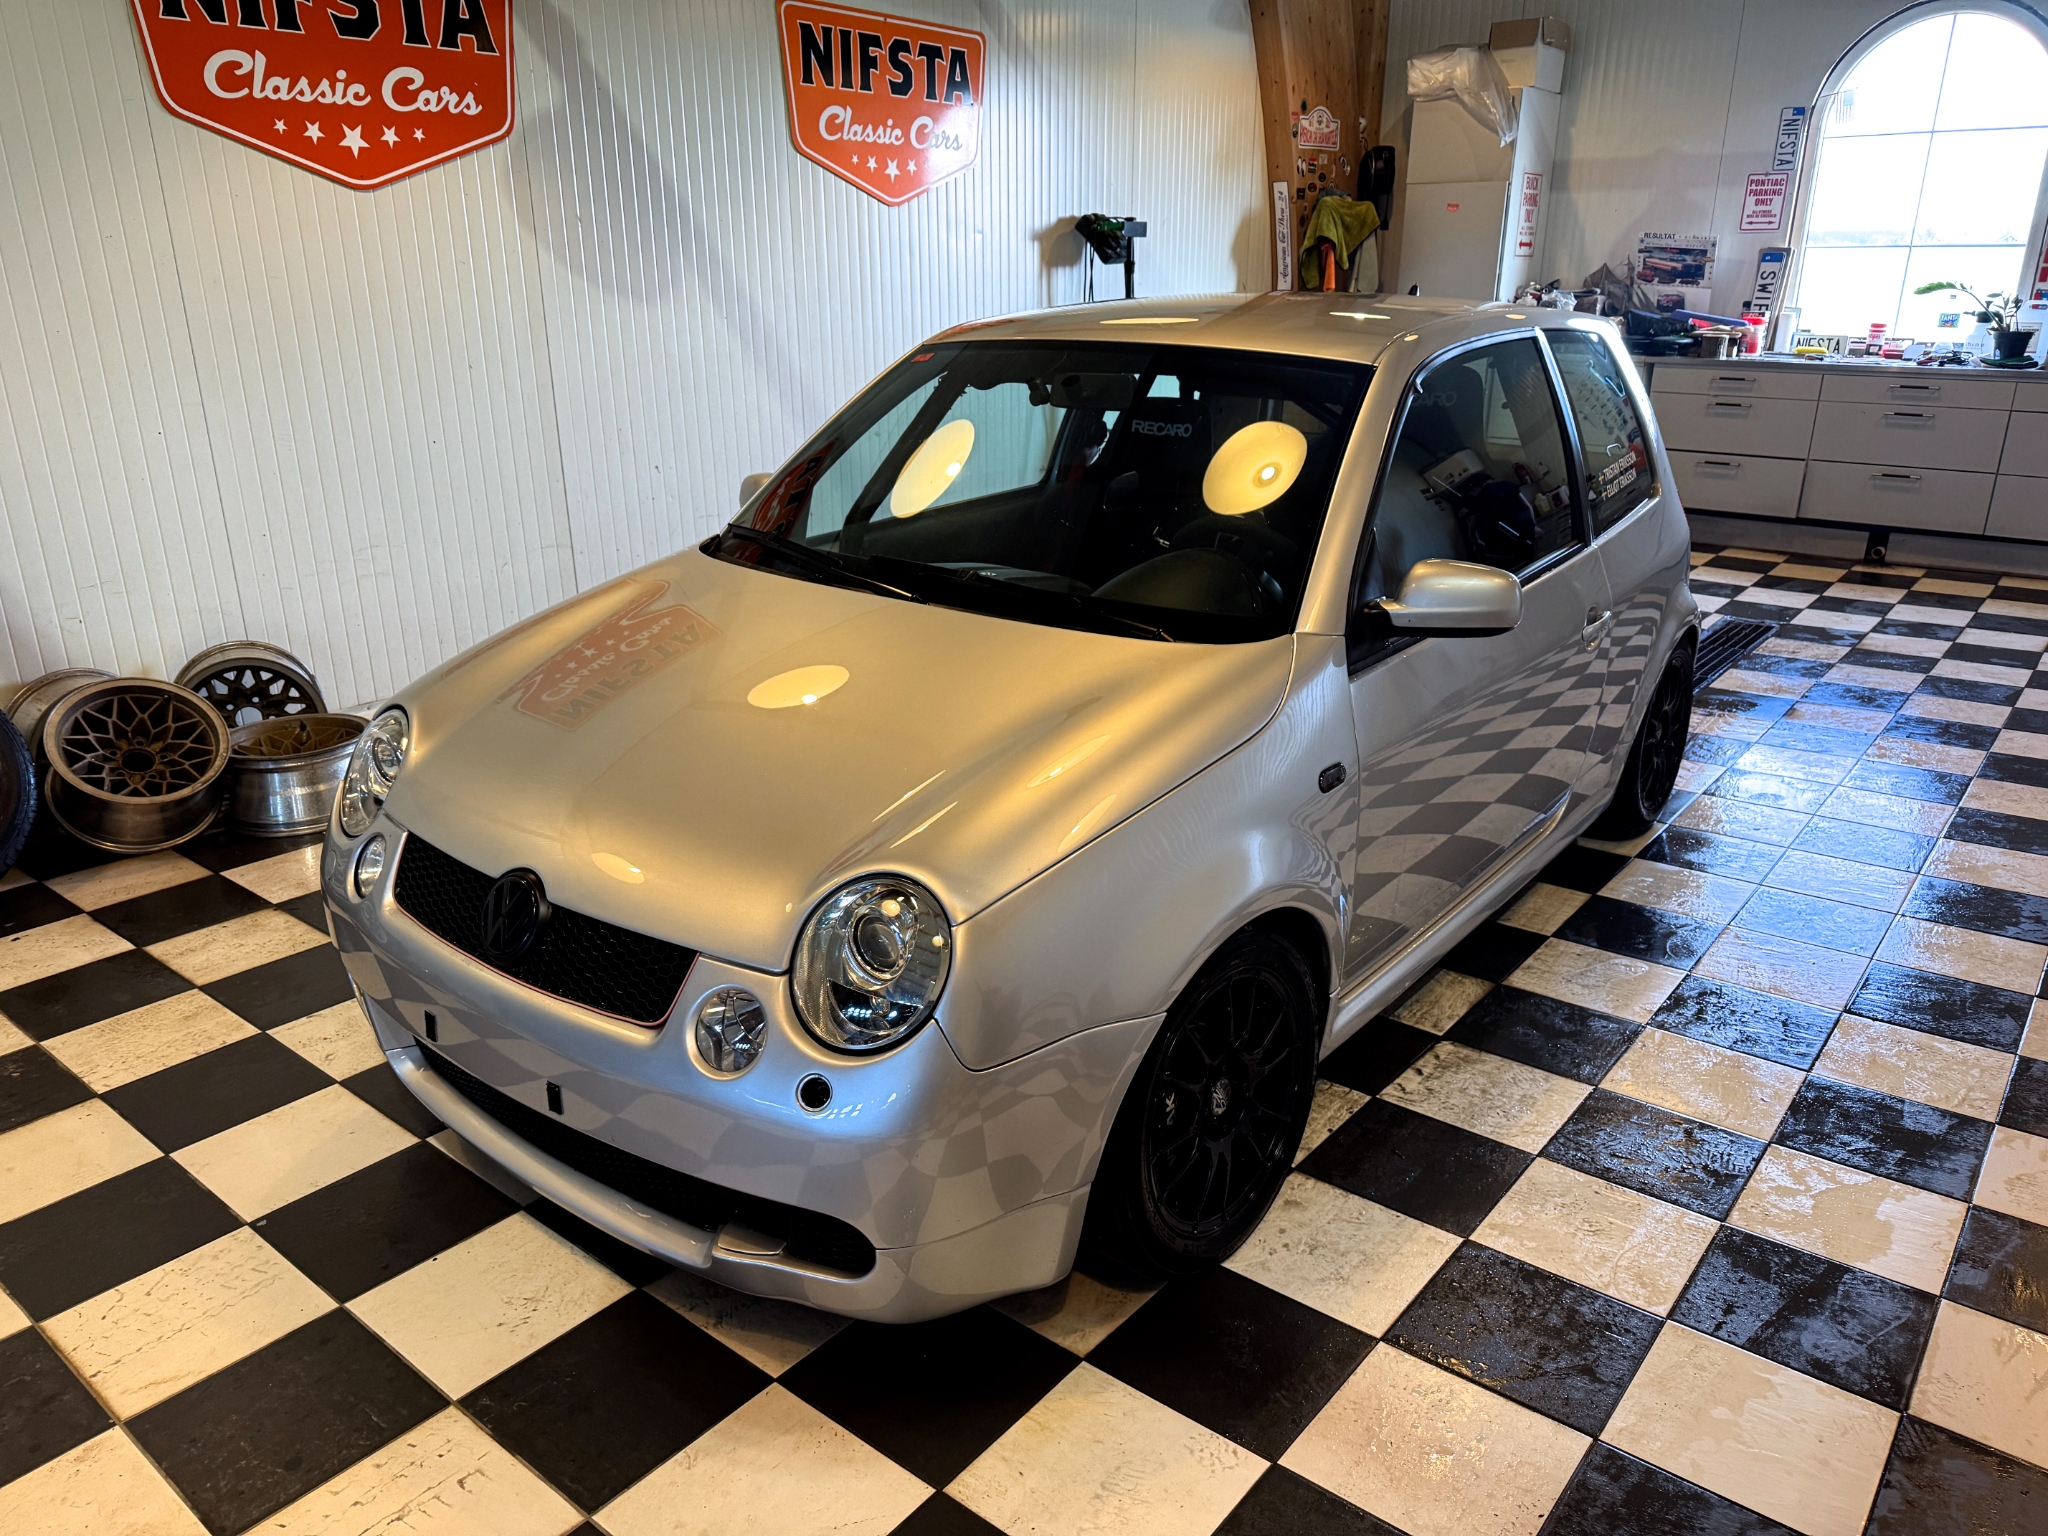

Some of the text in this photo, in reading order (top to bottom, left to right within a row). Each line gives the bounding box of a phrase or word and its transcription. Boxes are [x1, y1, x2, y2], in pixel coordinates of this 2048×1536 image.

[796, 19, 975, 106] NIFSTA
[203, 49, 483, 116] Classic Cars
[818, 104, 963, 151] Classic Cars
[1776, 118, 1801, 167] NIFSTA
[1526, 176, 1538, 190] BUICK
[1750, 178, 1785, 187] PONTIAC
[1748, 188, 1783, 197] PARKING
[1754, 198, 1773, 206] ONLY
[1643, 232, 1676, 240] RESULTAT
[1131, 419, 1193, 438] RECARO
